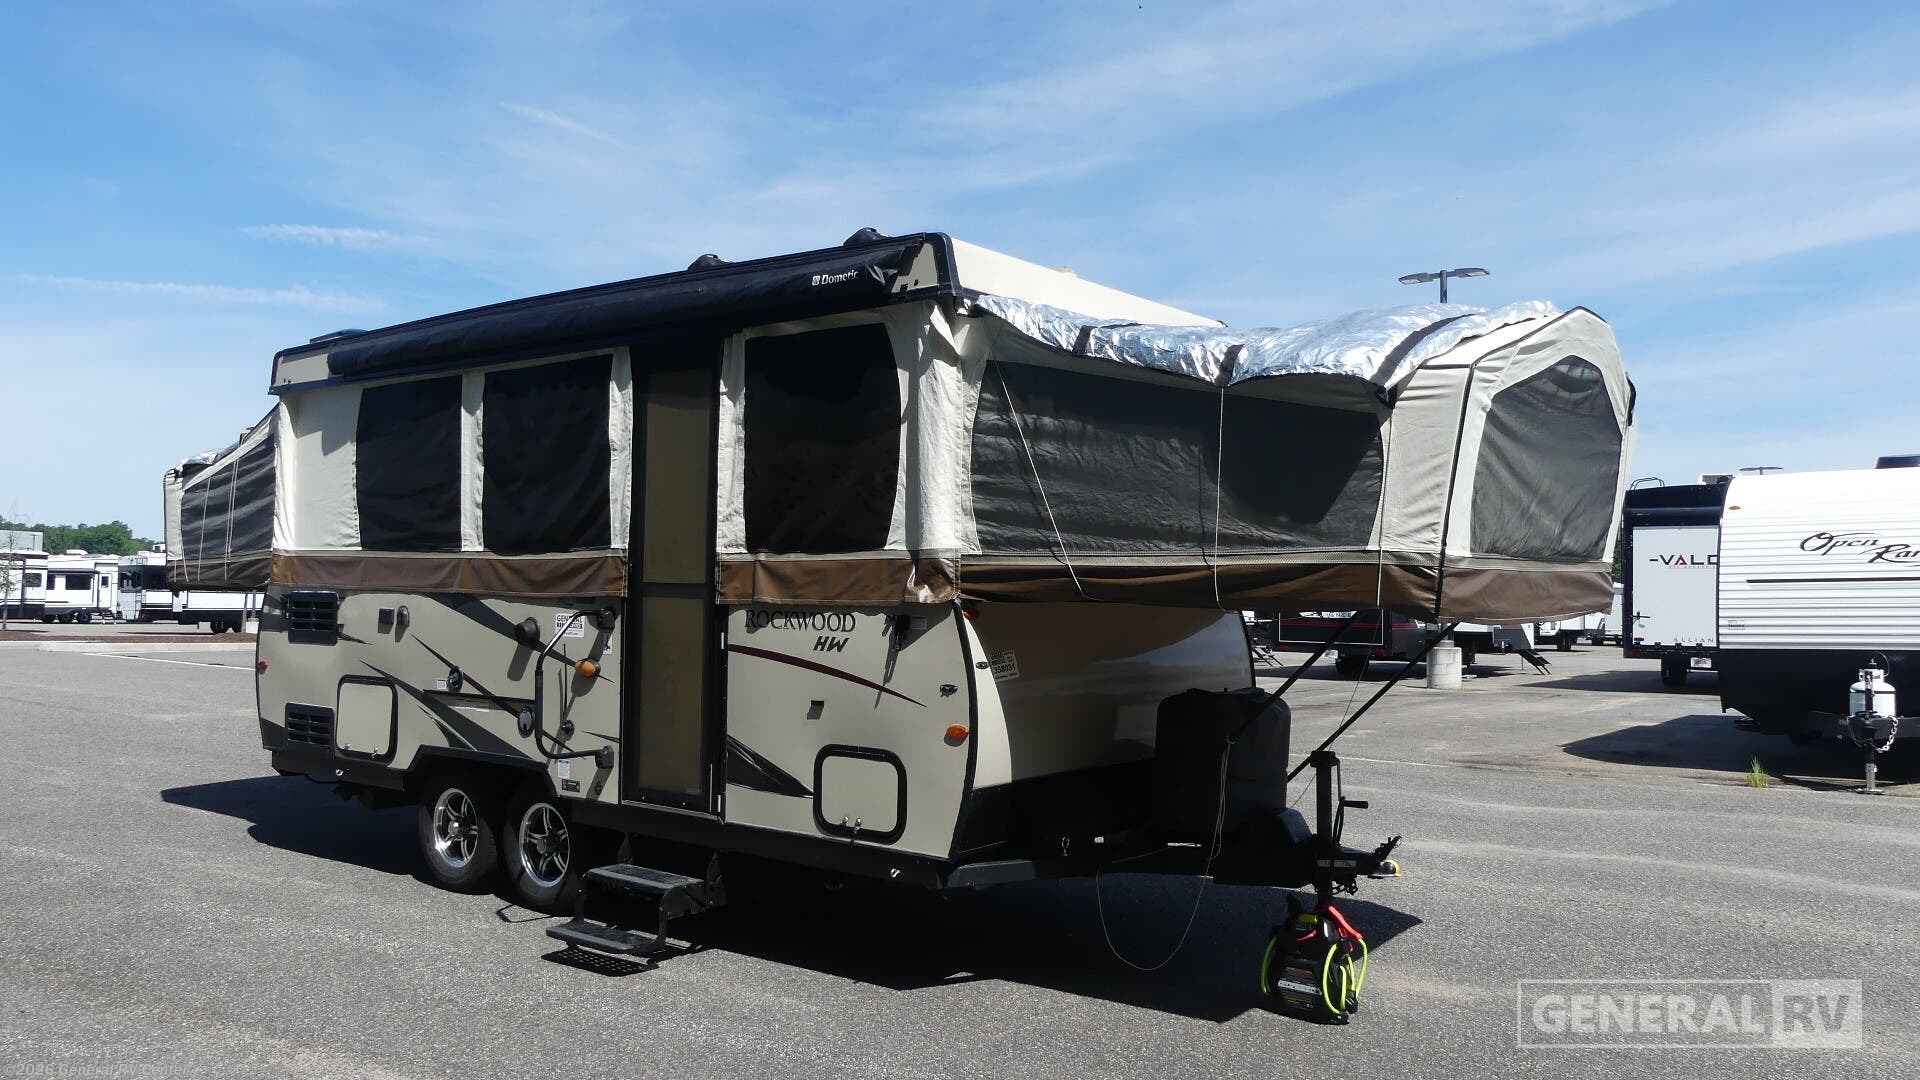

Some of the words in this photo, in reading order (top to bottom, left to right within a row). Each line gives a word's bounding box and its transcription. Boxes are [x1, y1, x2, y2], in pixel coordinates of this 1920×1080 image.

[821, 269, 859, 285] Dometic
[1800, 532, 1880, 556] Open
[744, 609, 856, 632] ROCKWOOD
[813, 635, 850, 653] HW
